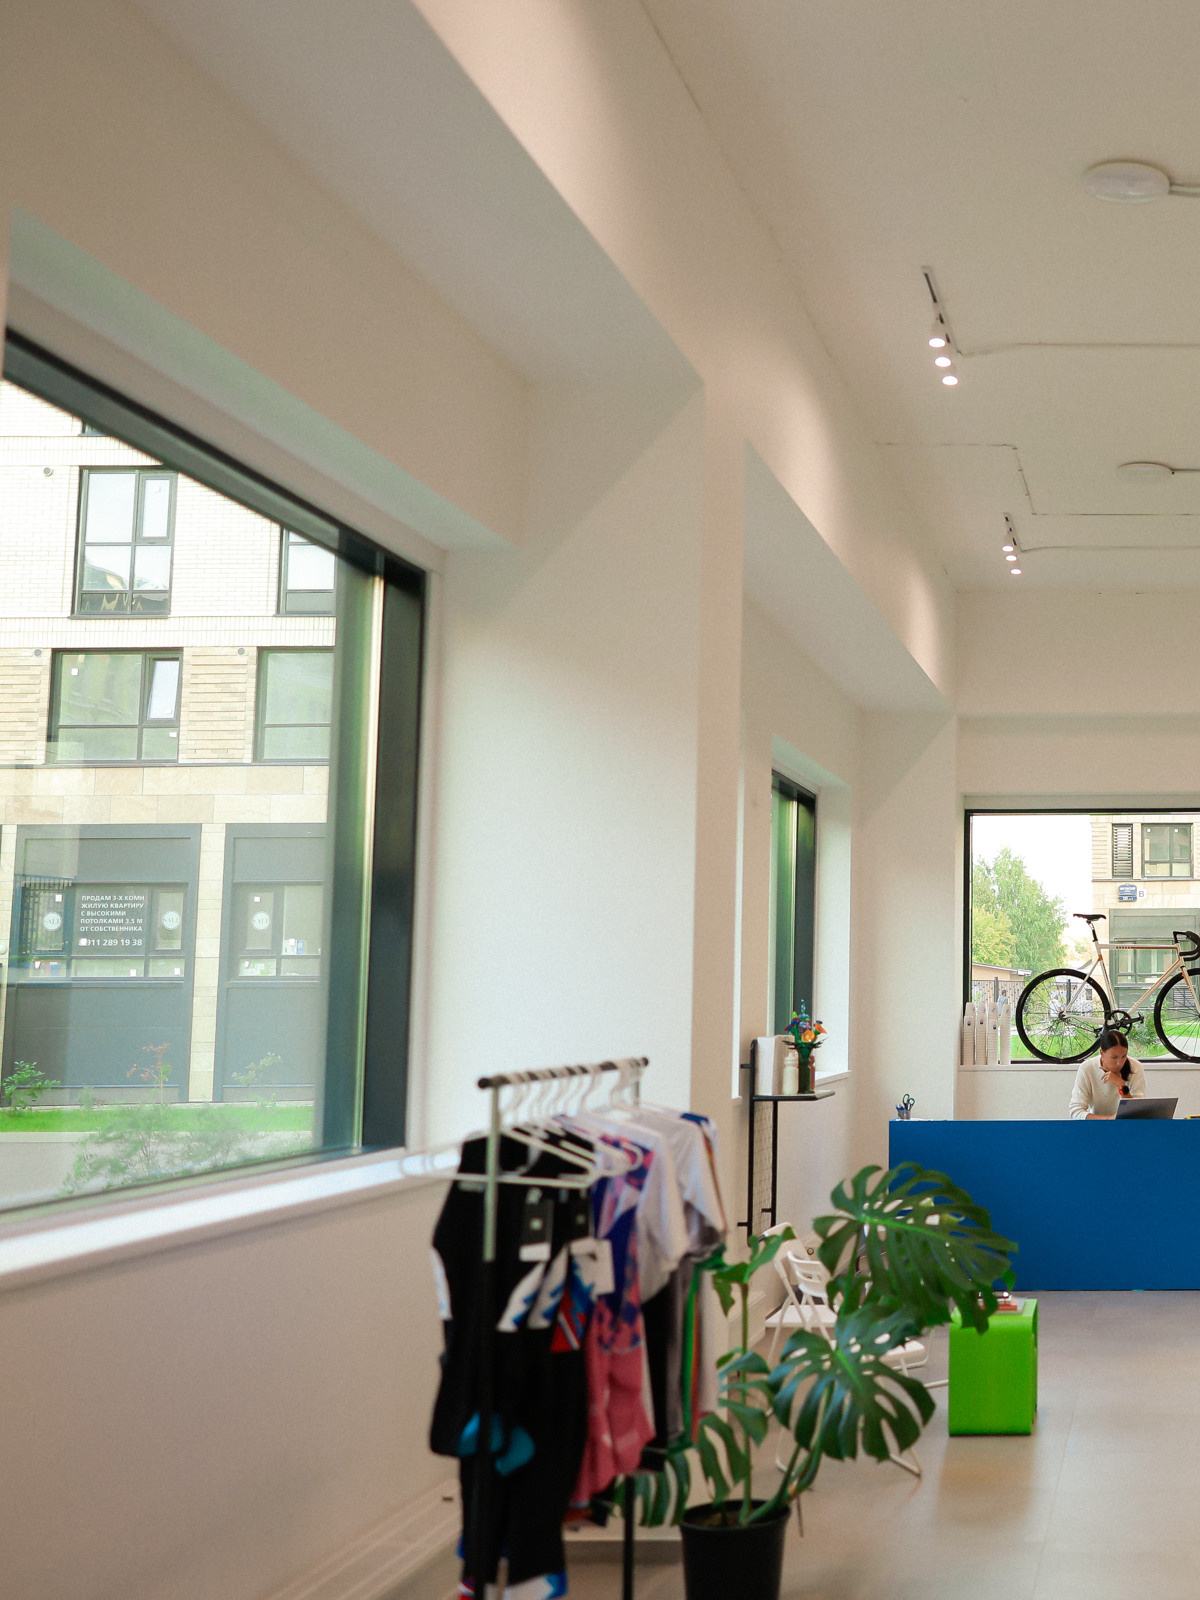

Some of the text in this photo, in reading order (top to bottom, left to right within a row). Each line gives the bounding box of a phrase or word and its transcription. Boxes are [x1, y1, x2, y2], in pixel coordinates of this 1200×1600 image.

[102, 938, 118, 946] 289
[120, 938, 131, 946] 19
[132, 938, 143, 946] 38
